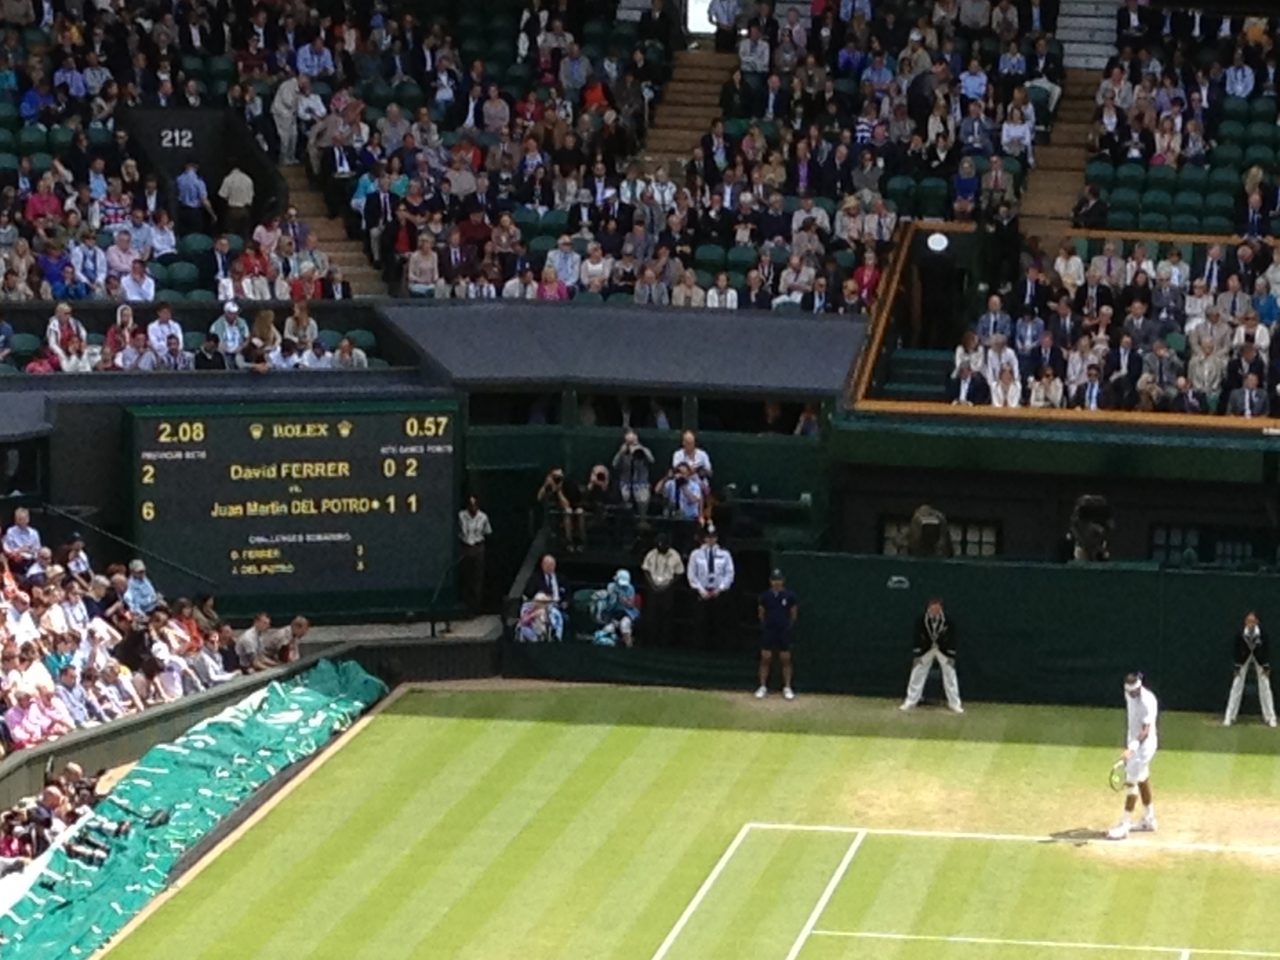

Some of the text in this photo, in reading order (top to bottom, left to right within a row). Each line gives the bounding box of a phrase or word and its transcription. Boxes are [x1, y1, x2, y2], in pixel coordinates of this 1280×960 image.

[161, 128, 193, 148] 212
[158, 422, 204, 443] 2.08
[273, 423, 329, 439] ROLEX
[405, 417, 448, 437] 0.57
[142, 465, 155, 484] 2
[230, 461, 350, 480] David FERRER
[383, 458, 418, 478] 0 2
[141, 501, 154, 520] 6
[211, 498, 370, 517] Juan Martin DEL POTRO
[386, 494, 417, 513] 1 1
